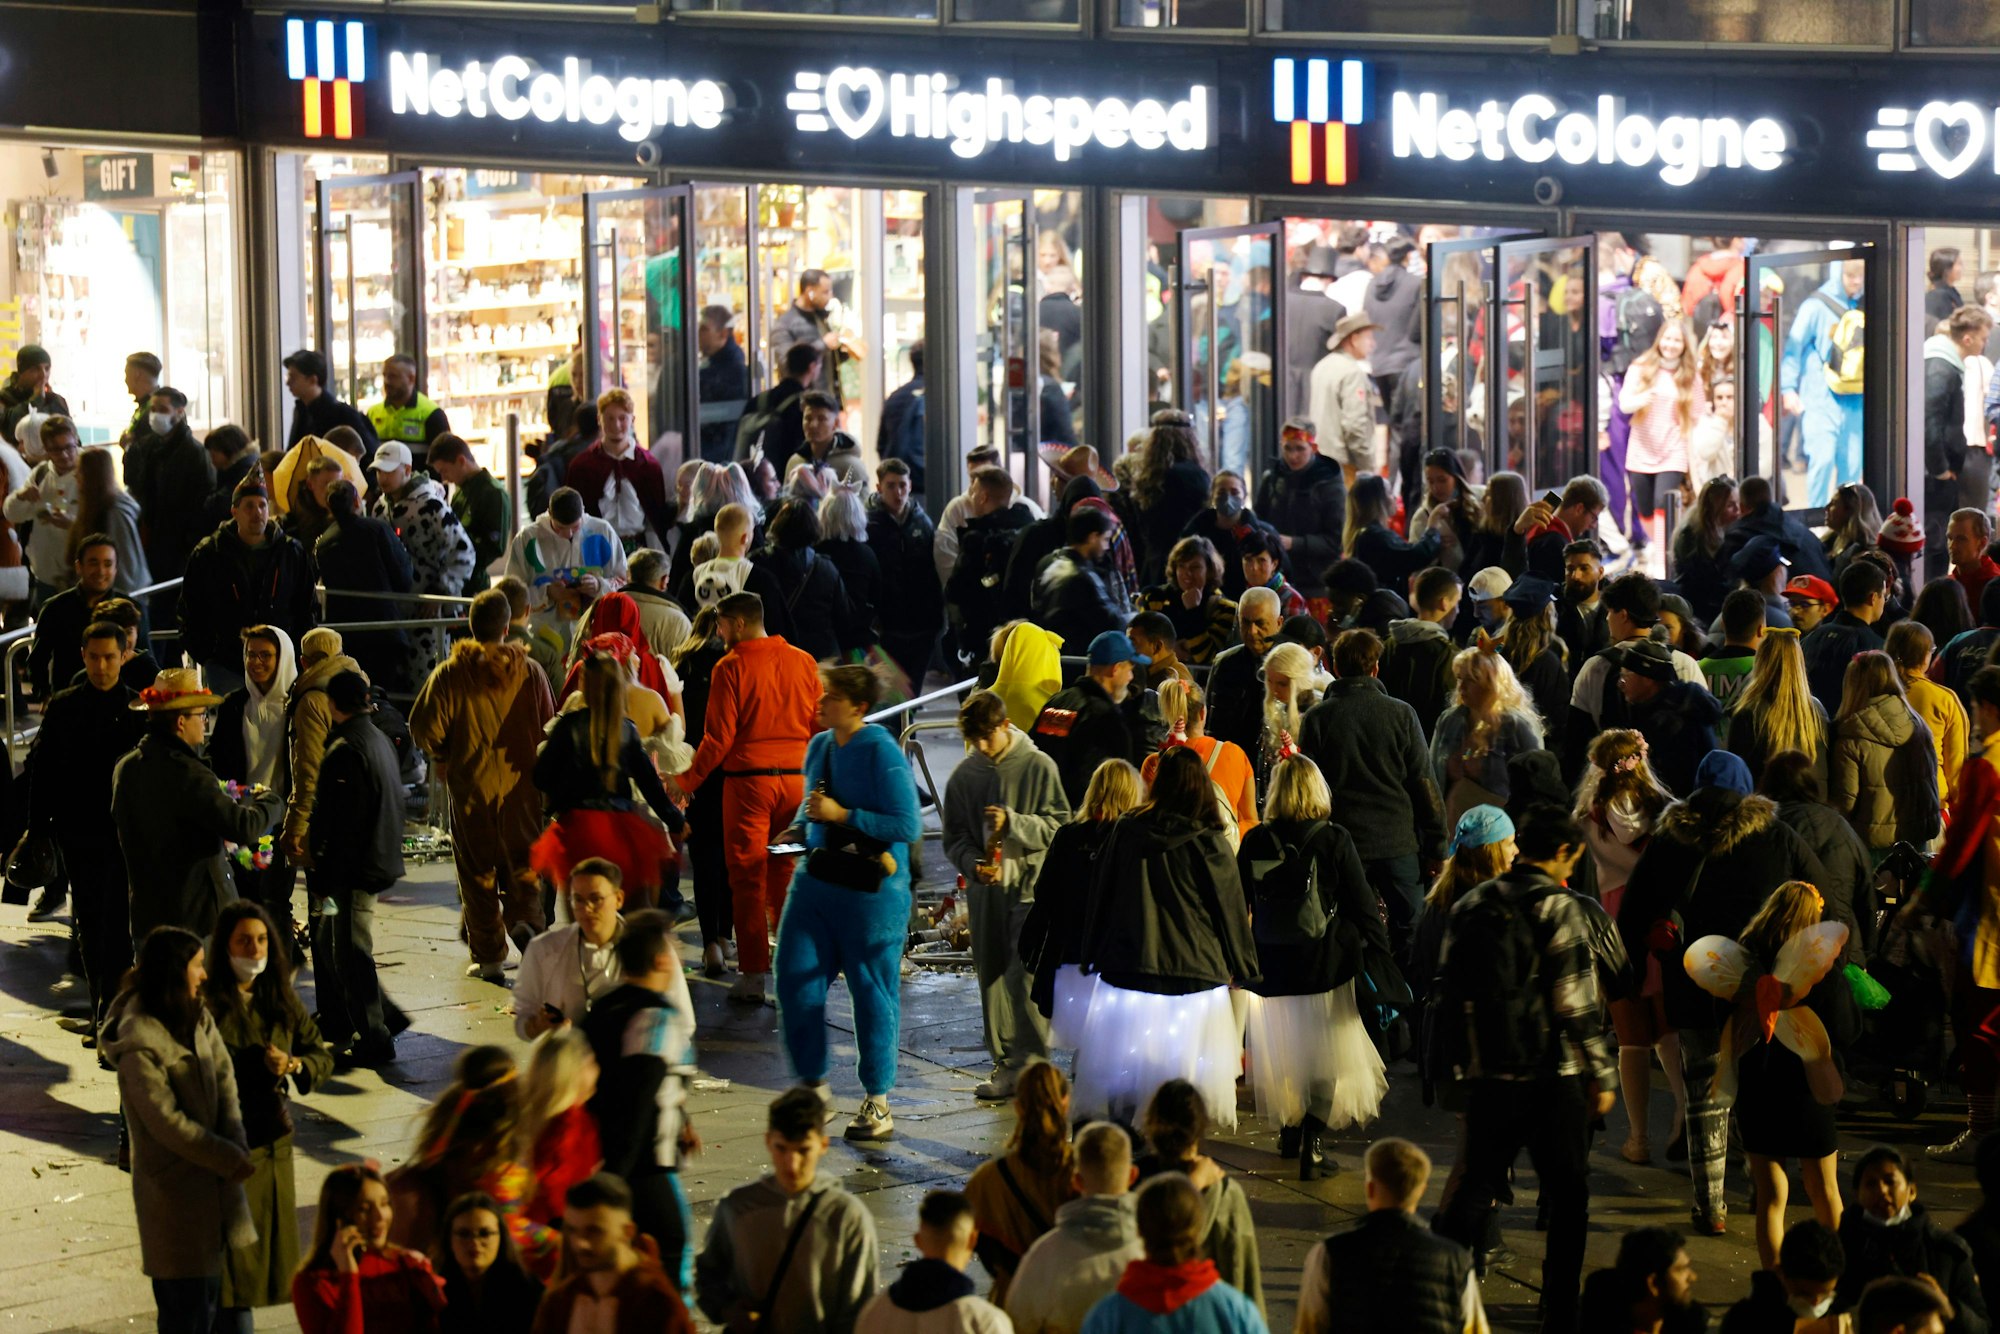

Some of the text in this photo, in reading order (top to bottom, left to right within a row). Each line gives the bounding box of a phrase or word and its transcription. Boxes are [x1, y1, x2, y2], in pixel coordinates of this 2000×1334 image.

[389, 51, 725, 142] NetCologne
[890, 73, 1208, 161] Highspeed
[1391, 91, 1787, 186] NetCologne
[100, 158, 137, 191] GIFT
